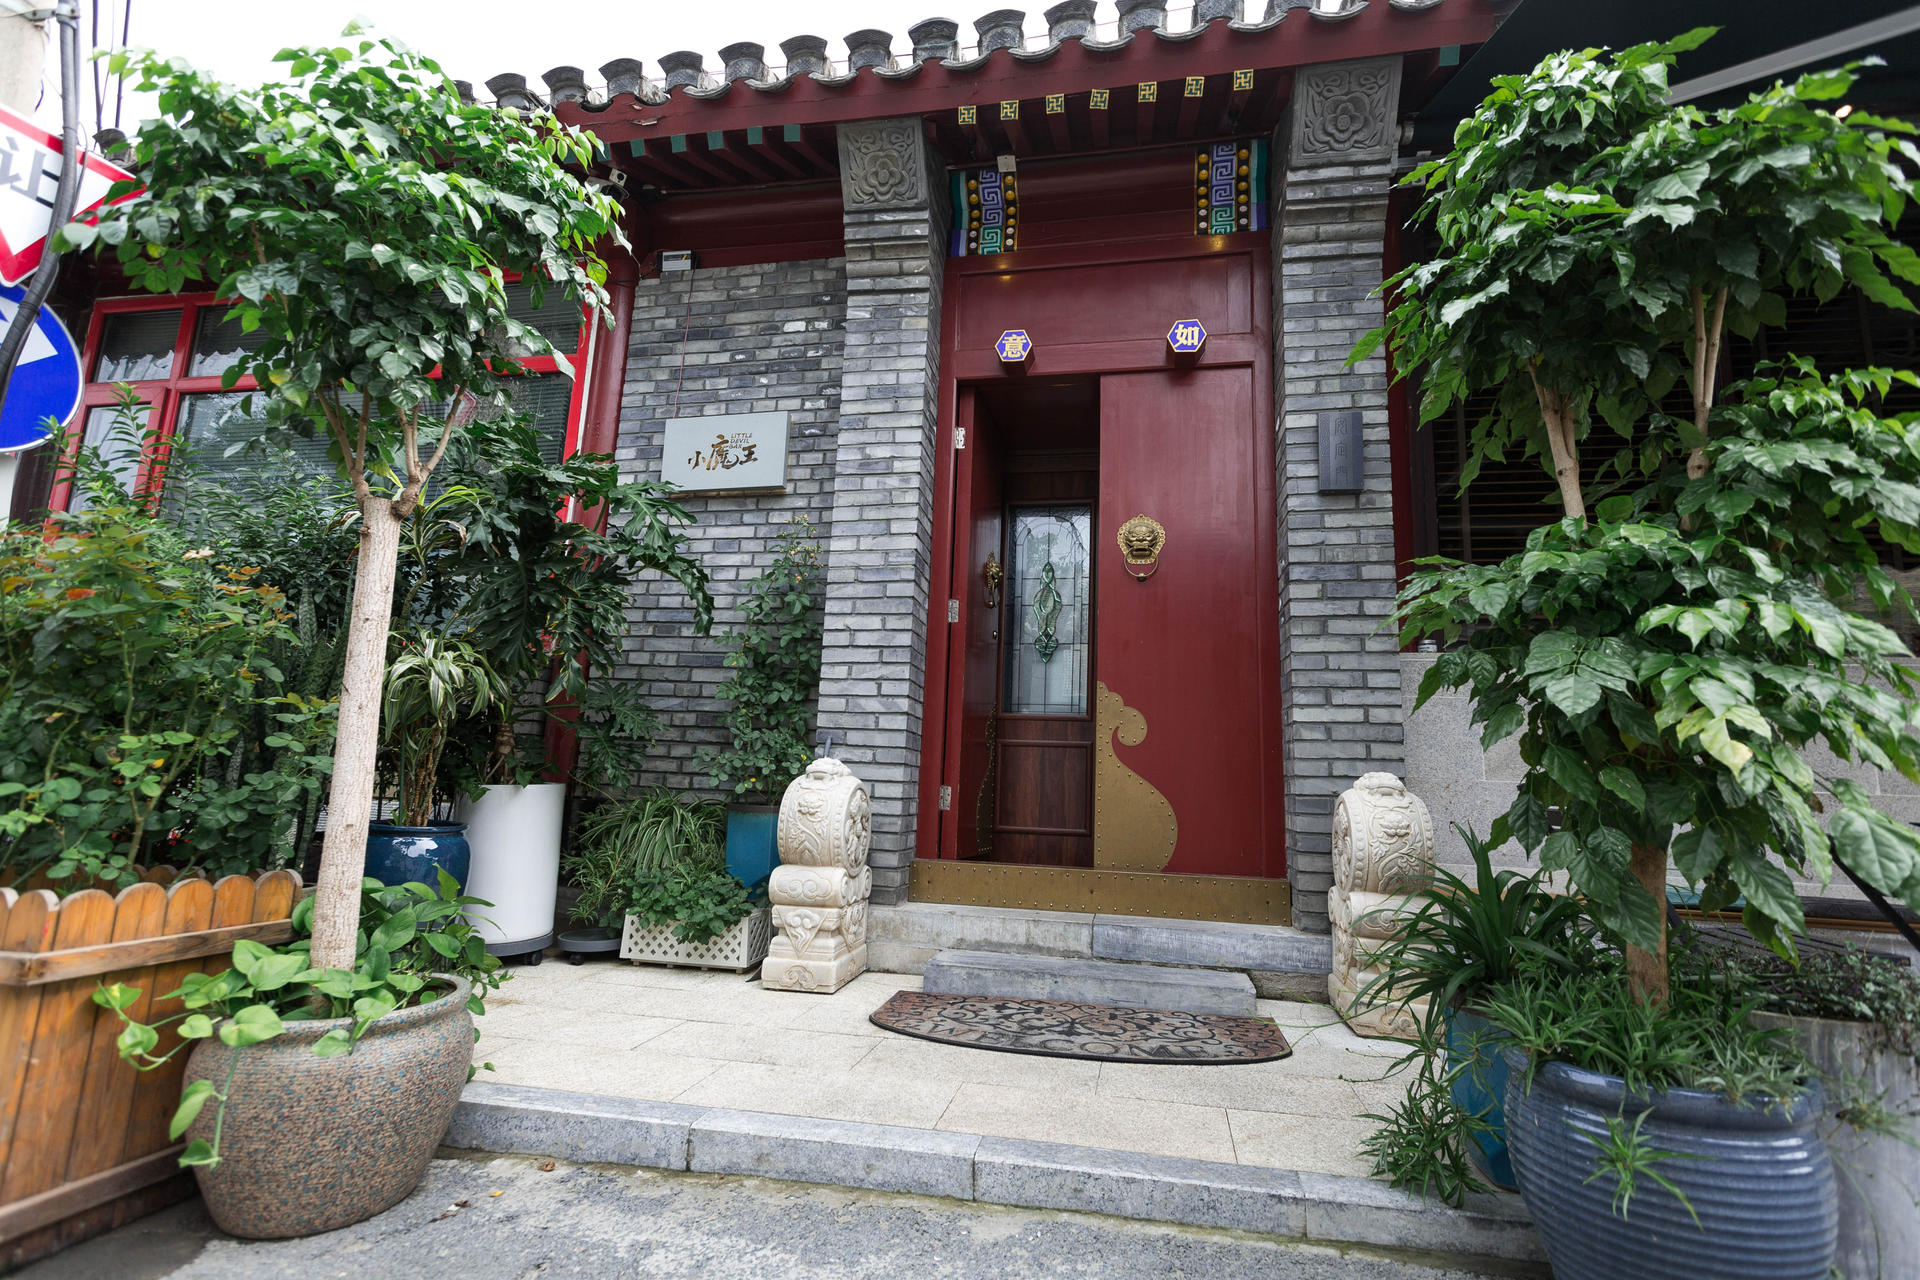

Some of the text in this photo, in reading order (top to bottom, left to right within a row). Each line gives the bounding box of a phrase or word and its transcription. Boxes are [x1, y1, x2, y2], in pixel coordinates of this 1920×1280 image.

[1002, 334, 1026, 358] 意
[1174, 323, 1200, 348] 如
[929, 1022, 1219, 1058] WELCOME
